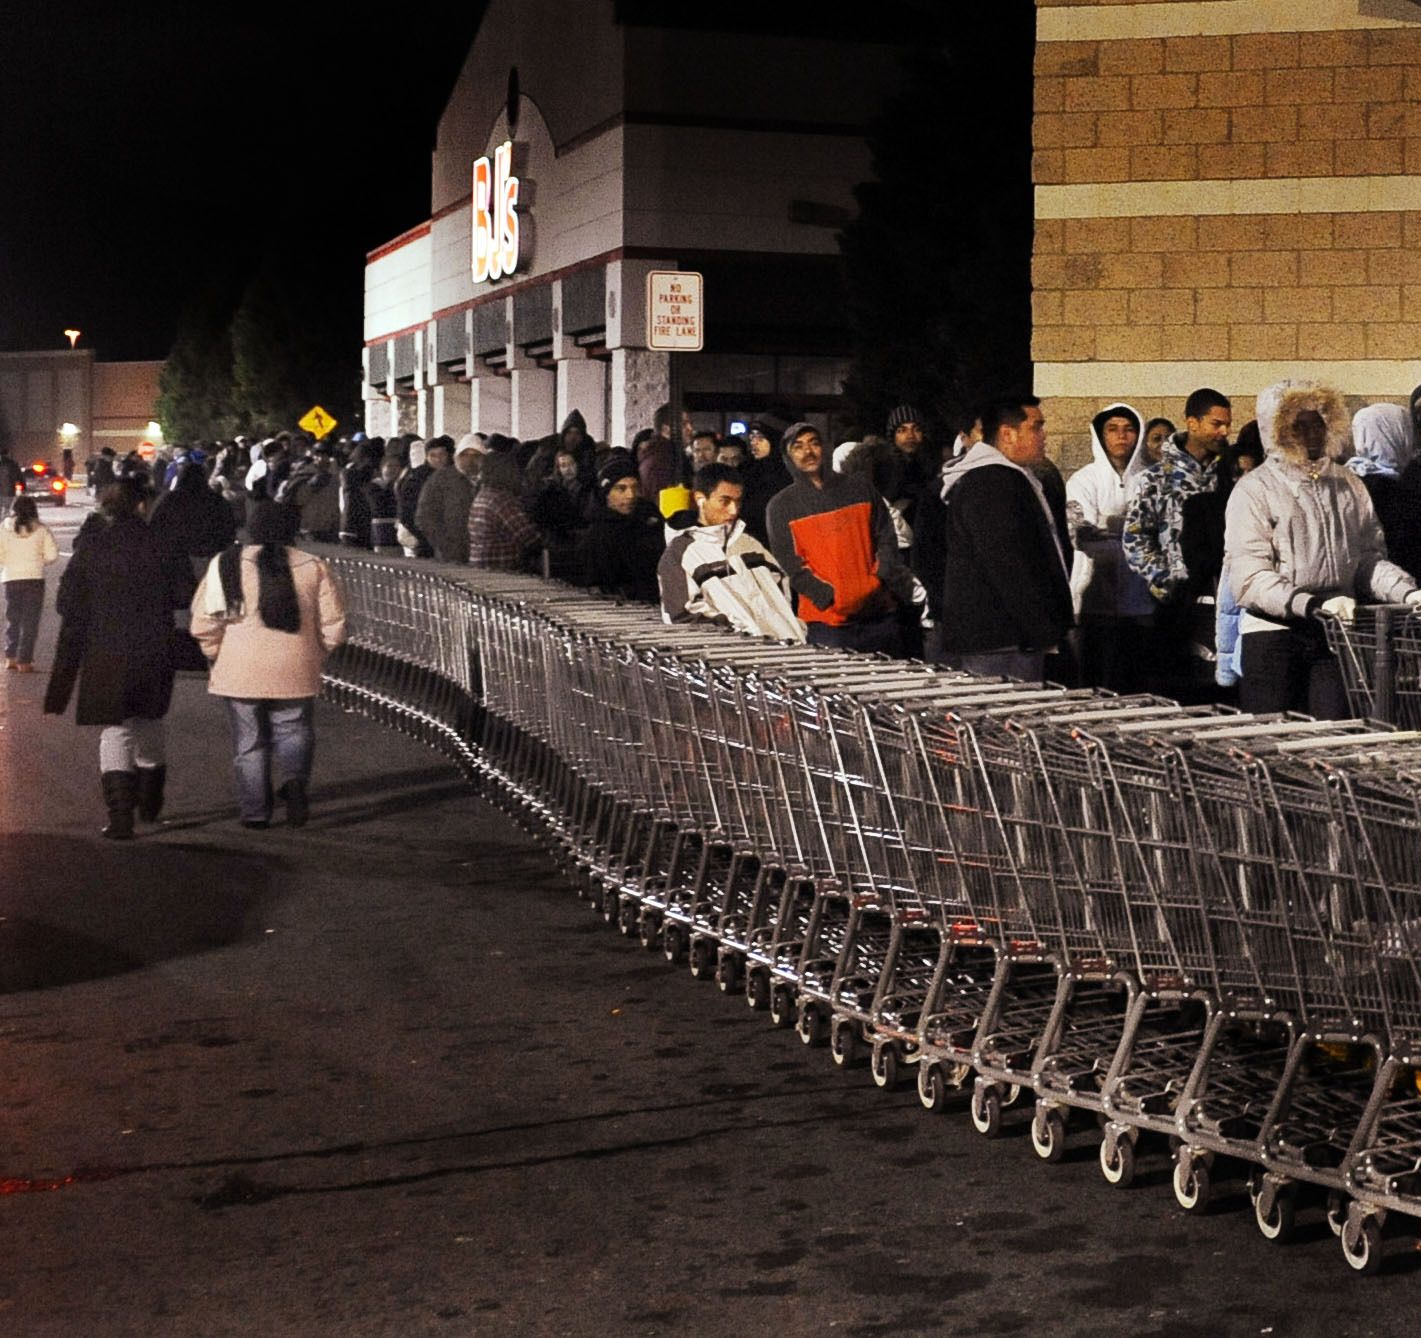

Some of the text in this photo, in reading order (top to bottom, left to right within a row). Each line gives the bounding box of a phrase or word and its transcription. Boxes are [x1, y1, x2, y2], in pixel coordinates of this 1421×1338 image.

[671, 284, 682, 292] NO
[659, 294, 693, 304] PARKING
[671, 305, 681, 314] OR
[657, 315, 696, 325] STANDING
[654, 326, 696, 336] FIRE LANE
